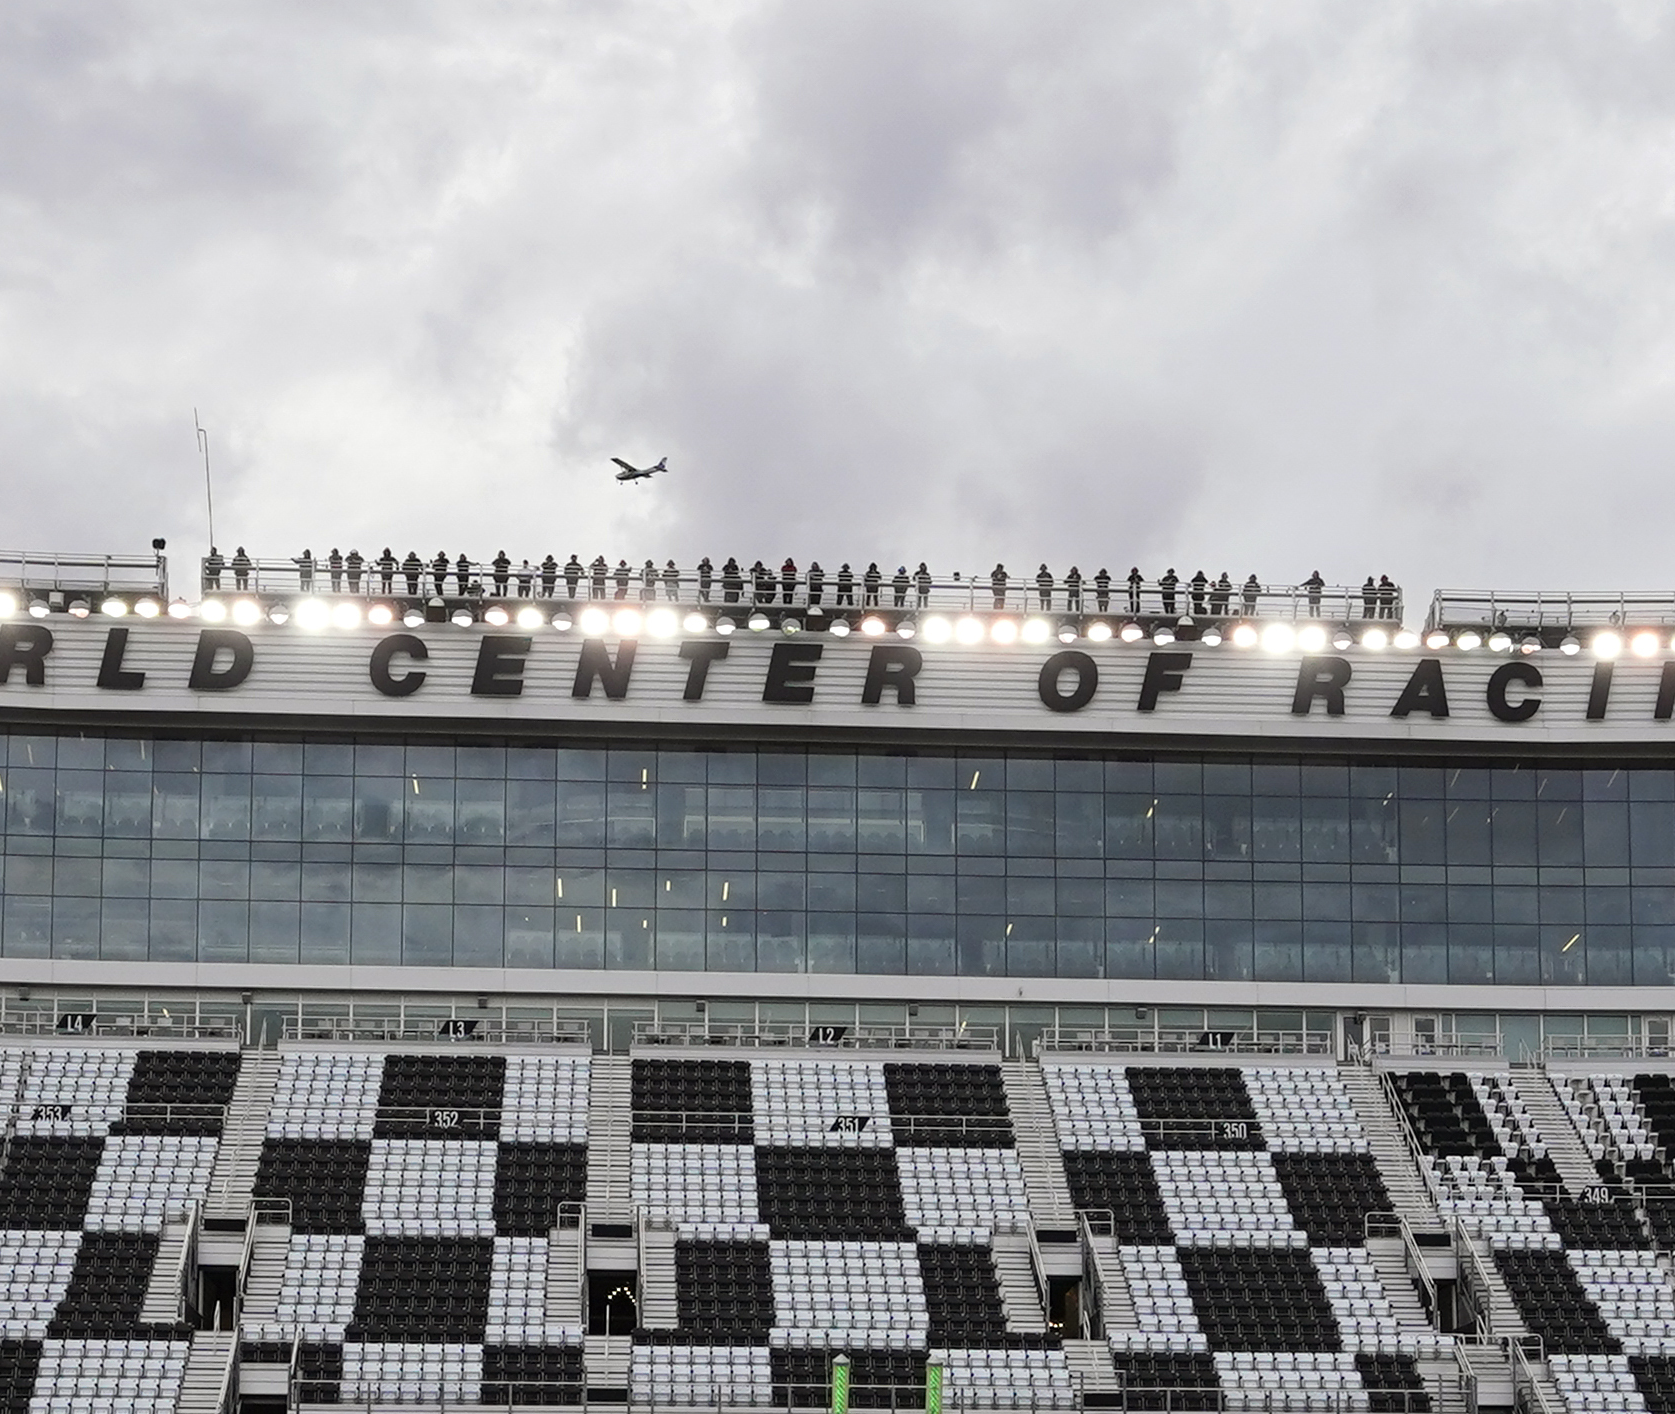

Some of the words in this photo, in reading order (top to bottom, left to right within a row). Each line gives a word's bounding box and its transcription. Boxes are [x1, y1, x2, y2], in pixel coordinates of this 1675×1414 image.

[369, 634, 924, 706] CENTER
[1037, 651, 1193, 714] OF
[67, 1015, 83, 1031] L4
[449, 1021, 465, 1038] L3
[819, 1027, 835, 1044] L2
[1208, 1032, 1222, 1050] L1
[38, 1106, 63, 1121] 353
[434, 1111, 459, 1128] 352
[837, 1117, 860, 1132] 351
[1224, 1123, 1248, 1140] 350
[1584, 1187, 1610, 1204] 349
